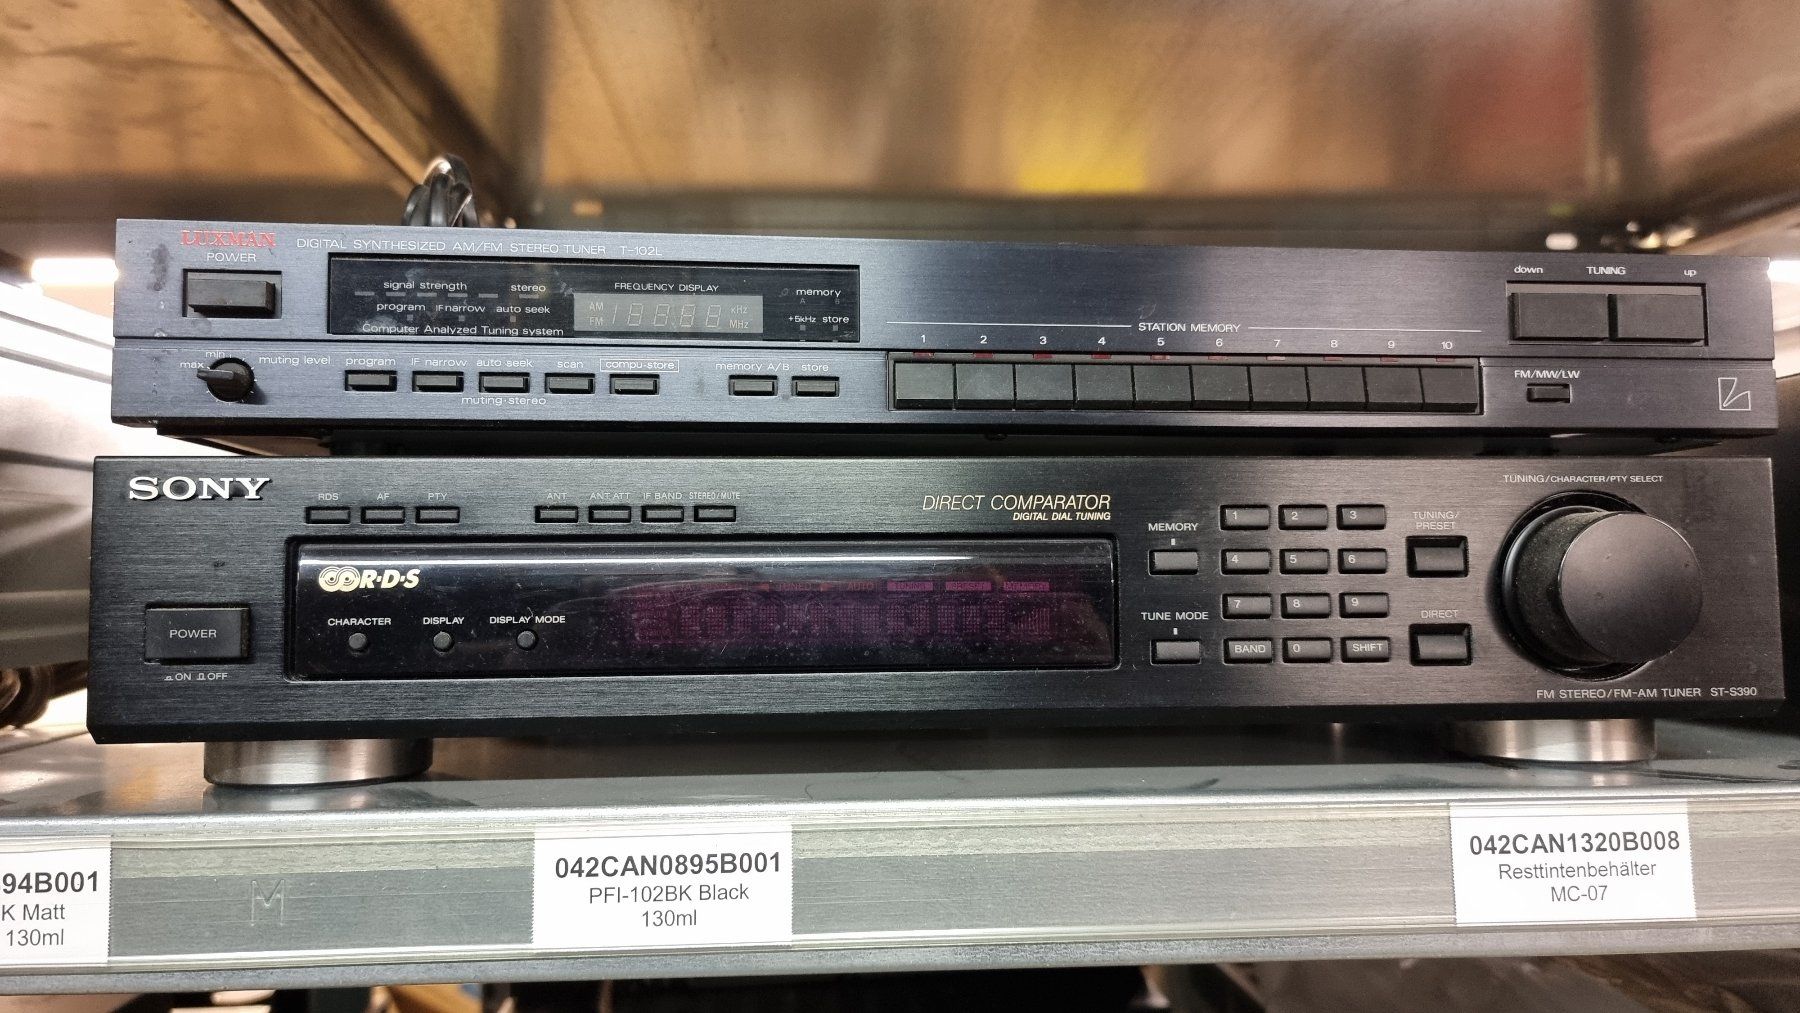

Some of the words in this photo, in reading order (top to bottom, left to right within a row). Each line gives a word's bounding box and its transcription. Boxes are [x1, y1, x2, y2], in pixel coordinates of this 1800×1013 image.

[180, 230, 277, 247] LUXMAN
[297, 239, 347, 249] DIGITAL
[353, 240, 446, 251] SYNTHESIZED
[453, 241, 503, 252] AM/FM
[510, 243, 559, 254] STEREO
[564, 244, 606, 255] TUNER
[620, 246, 663, 257] T-102L
[206, 252, 257, 262] POWER
[1513, 265, 1544, 274] down
[1586, 266, 1626, 275] TUNING
[1684, 269, 1697, 277] up
[383, 280, 415, 290] signal
[419, 281, 467, 291] strength
[510, 283, 547, 292] stereo
[614, 282, 674, 292] FREQUENCY
[679, 283, 719, 293] DISPLAY
[796, 288, 842, 298] memory
[376, 302, 426, 312] program
[496, 305, 522, 313] auto
[525, 305, 550, 314] seek
[589, 301, 604, 311] AM
[729, 319, 749, 329] MHz
[788, 315, 817, 324] +5kHz
[822, 315, 850, 324] store
[362, 323, 419, 337] Computer
[424, 324, 477, 337] Analyzed
[481, 325, 519, 338] Tuning
[522, 326, 564, 338] system
[1138, 322, 1185, 332] STATION
[1190, 323, 1241, 333] MEMORY
[920, 335, 926, 344] 1
[980, 335, 988, 345] 2
[1039, 336, 1047, 345] 3
[1098, 337, 1106, 346] 4
[1157, 337, 1165, 346] 5
[1215, 338, 1223, 347] 6
[1273, 339, 1281, 348] 7
[1330, 340, 1338, 348] 8
[1387, 340, 1395, 349] 9
[1441, 341, 1453, 350] 10
[205, 349, 226, 358] min
[180, 361, 204, 370] max
[259, 355, 299, 366] muting
[303, 355, 331, 365] level
[345, 356, 396, 369] program
[411, 357, 420, 366] IF
[425, 359, 468, 367] narrow
[476, 359, 502, 367] auto
[505, 358, 533, 368] seek
[557, 360, 584, 369] scan
[715, 363, 763, 372] memory
[767, 362, 790, 372] A/B
[801, 363, 829, 372] store
[1514, 369, 1580, 379] FM/MW/LW
[1629, 475, 1664, 483] SELECT
[128, 476, 271, 501] SONY
[317, 492, 339, 501] RDS
[376, 492, 390, 501] AF
[427, 492, 448, 500] PTY
[546, 492, 567, 500] ANT
[612, 492, 630, 500] ATT
[643, 492, 651, 500] IF
[654, 492, 683, 500] BAND
[688, 491, 741, 500] STEREO/MUTE
[922, 494, 986, 511] DIRECT
[990, 494, 1111, 510] COMPARATOR
[1012, 512, 1048, 521] DIGITAL
[1051, 512, 1073, 520] DIAL
[1075, 512, 1111, 520] TUNING
[1232, 511, 1239, 520] 1
[1291, 511, 1299, 521] 2
[1349, 511, 1357, 520] 3
[1148, 523, 1199, 532] MEMORY
[1416, 521, 1457, 530] PRESET
[1231, 554, 1239, 564] 4
[1289, 554, 1297, 564] 5
[1348, 554, 1356, 564] 6
[1233, 599, 1241, 609] 7
[1293, 599, 1301, 609] 8
[1351, 597, 1359, 607] 9
[1141, 611, 1172, 621] TUNE
[1175, 611, 1209, 621] MODE
[1421, 609, 1459, 619] DIRECT
[327, 617, 392, 626] CHARACTER
[422, 616, 465, 625] DISPLAY
[489, 616, 530, 624] DISPLAY
[535, 615, 566, 624] MODE
[169, 629, 217, 639] POWER
[1234, 644, 1266, 653] BAND
[1352, 642, 1383, 652] SHIFT
[174, 672, 192, 681] ON
[207, 672, 228, 680] OFF
[1536, 689, 1555, 699] FM
[1559, 688, 1658, 699] STEREO/FM-AM
[1661, 687, 1702, 698] TUNER
[1710, 687, 1757, 697] ST-S390
[1469, 830, 1680, 855] 042CAN1320B008
[555, 851, 780, 878] 042CAN0895B001
[1498, 861, 1657, 880] Resttintenbehälter
[589, 884, 692, 904] PFI-102BK
[698, 883, 749, 901] Black
[1550, 885, 1608, 902] MC-07
[22, 903, 66, 921] Matt
[641, 909, 697, 927] 130ml
[6, 928, 64, 946] 130ml
